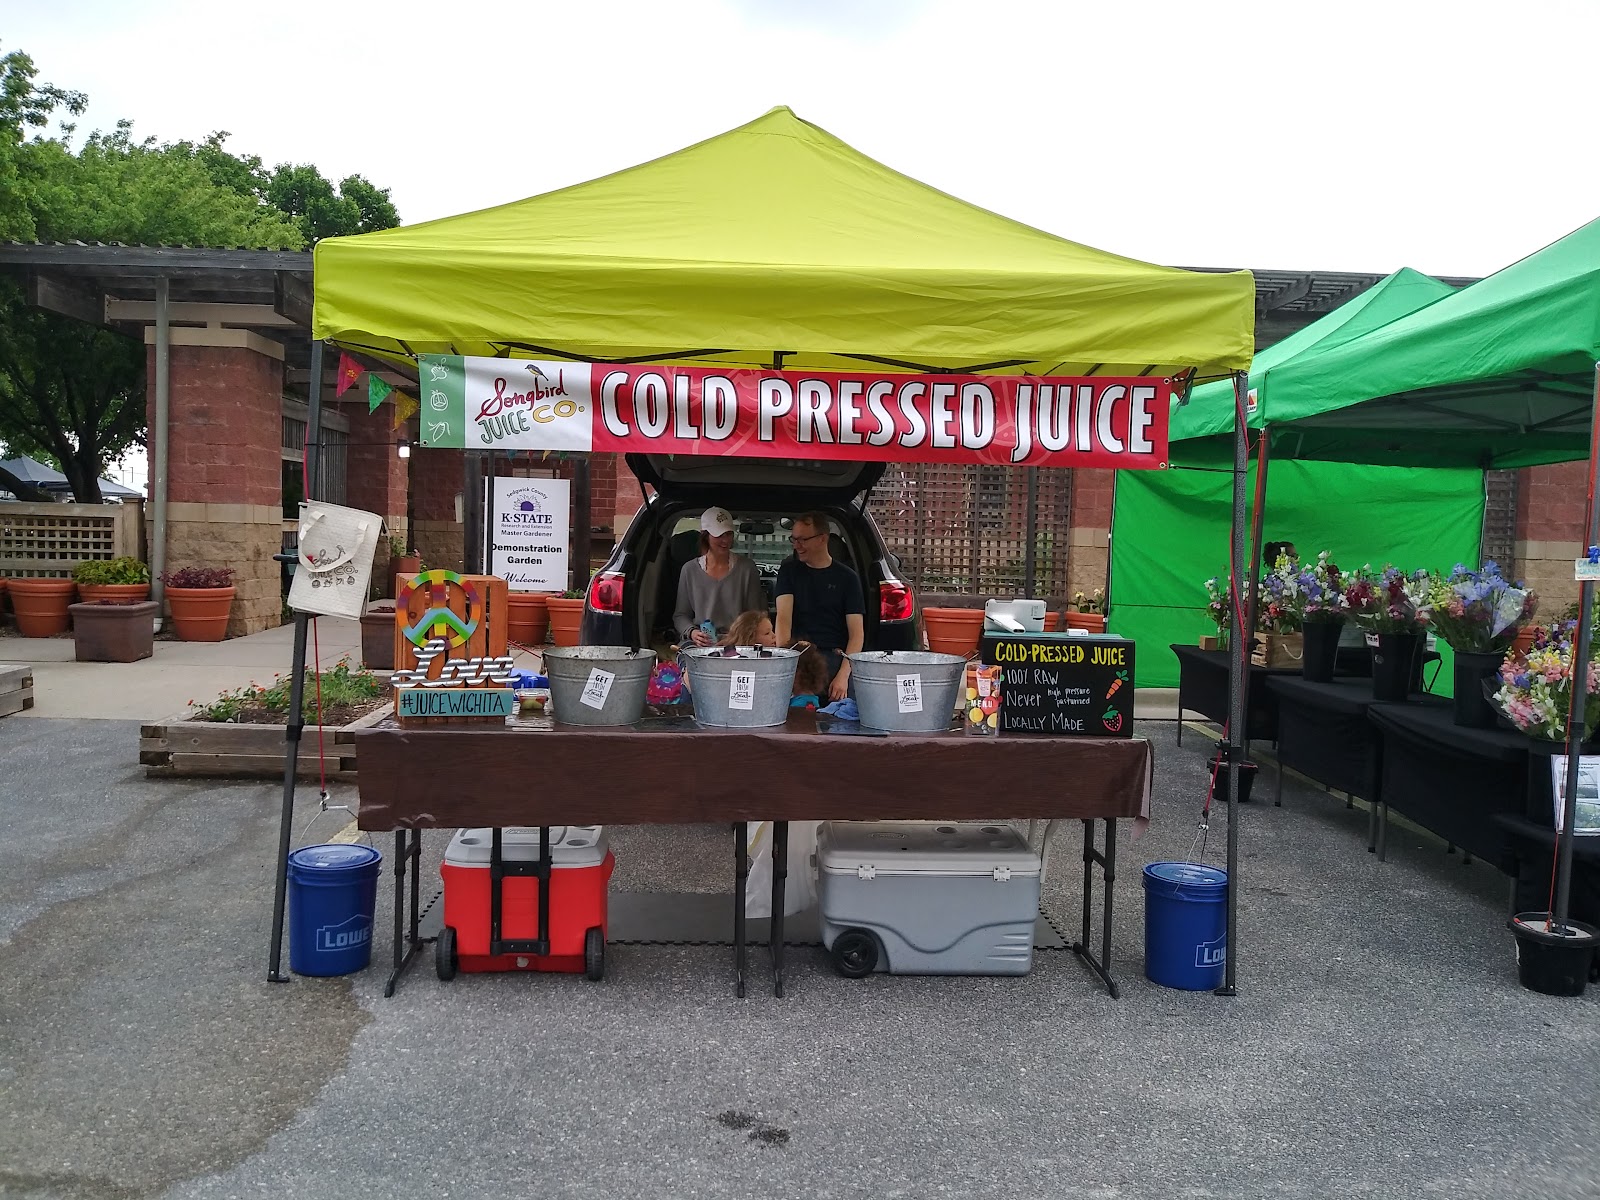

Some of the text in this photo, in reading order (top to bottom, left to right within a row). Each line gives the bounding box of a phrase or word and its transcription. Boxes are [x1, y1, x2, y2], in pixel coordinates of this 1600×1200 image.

[475, 369, 568, 420] Songbird
[477, 400, 585, 444] JUICE CO.
[601, 371, 1157, 463] COLD PRESSED JUICE
[531, 488, 548, 500] County
[492, 543, 562, 553] Demonstration
[507, 556, 542, 565] Garden
[504, 572, 548, 584] Welcome
[390, 638, 521, 688] Love
[1091, 646, 1126, 666] JUICE
[595, 674, 608, 684] GET
[736, 676, 750, 684] GET
[903, 679, 915, 687] GET
[1034, 669, 1059, 685] RAW
[401, 692, 504, 714] #JUICEWICHITA
[970, 699, 993, 708] MENU
[1006, 687, 1091, 707] Never high pressure
